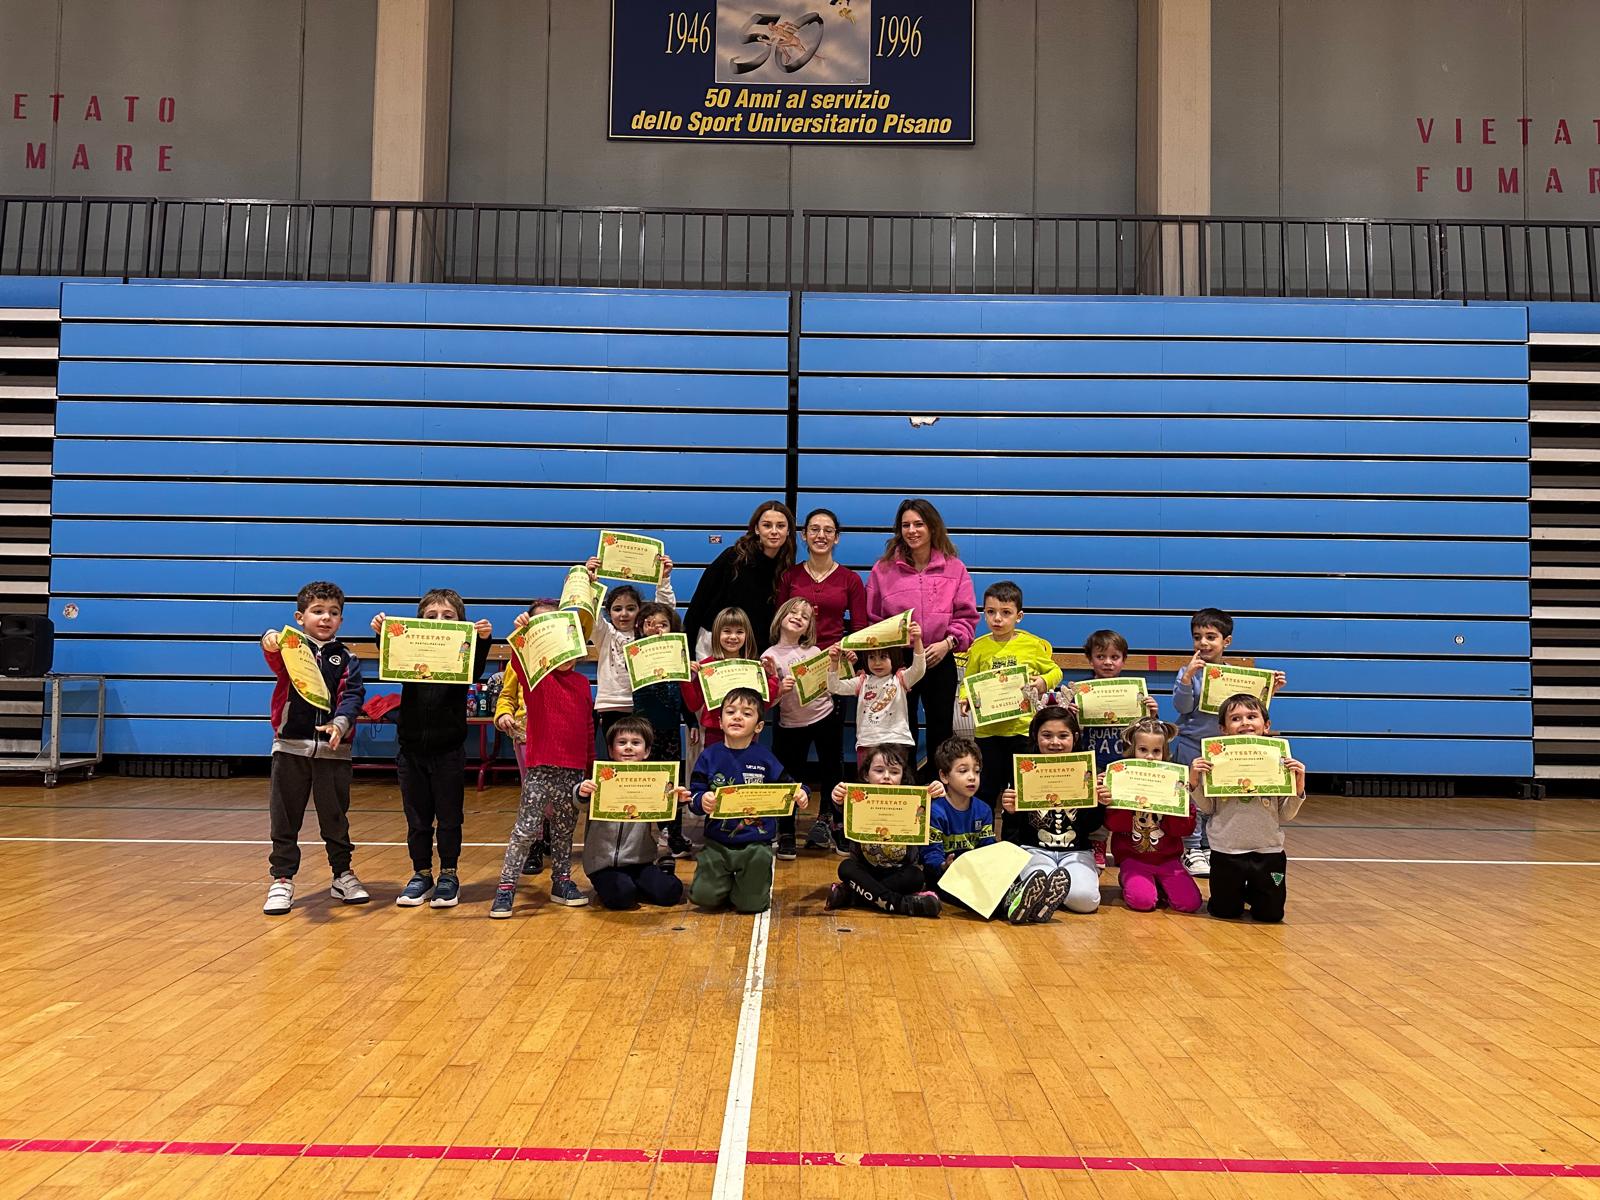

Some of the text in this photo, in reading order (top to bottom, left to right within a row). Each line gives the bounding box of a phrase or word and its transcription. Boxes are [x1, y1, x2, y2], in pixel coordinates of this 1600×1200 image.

[665, 11, 712, 54] 1946
[875, 15, 923, 58] 1996
[704, 88, 891, 110] 50 Anni al servizio
[631, 110, 952, 136] dello Sport Universitario Pisano
[25, 142, 174, 172] MARE
[1416, 166, 1600, 194] FUMAR
[405, 634, 451, 642] ATTESTATO
[1125, 770, 1166, 779] ATTESTATO
